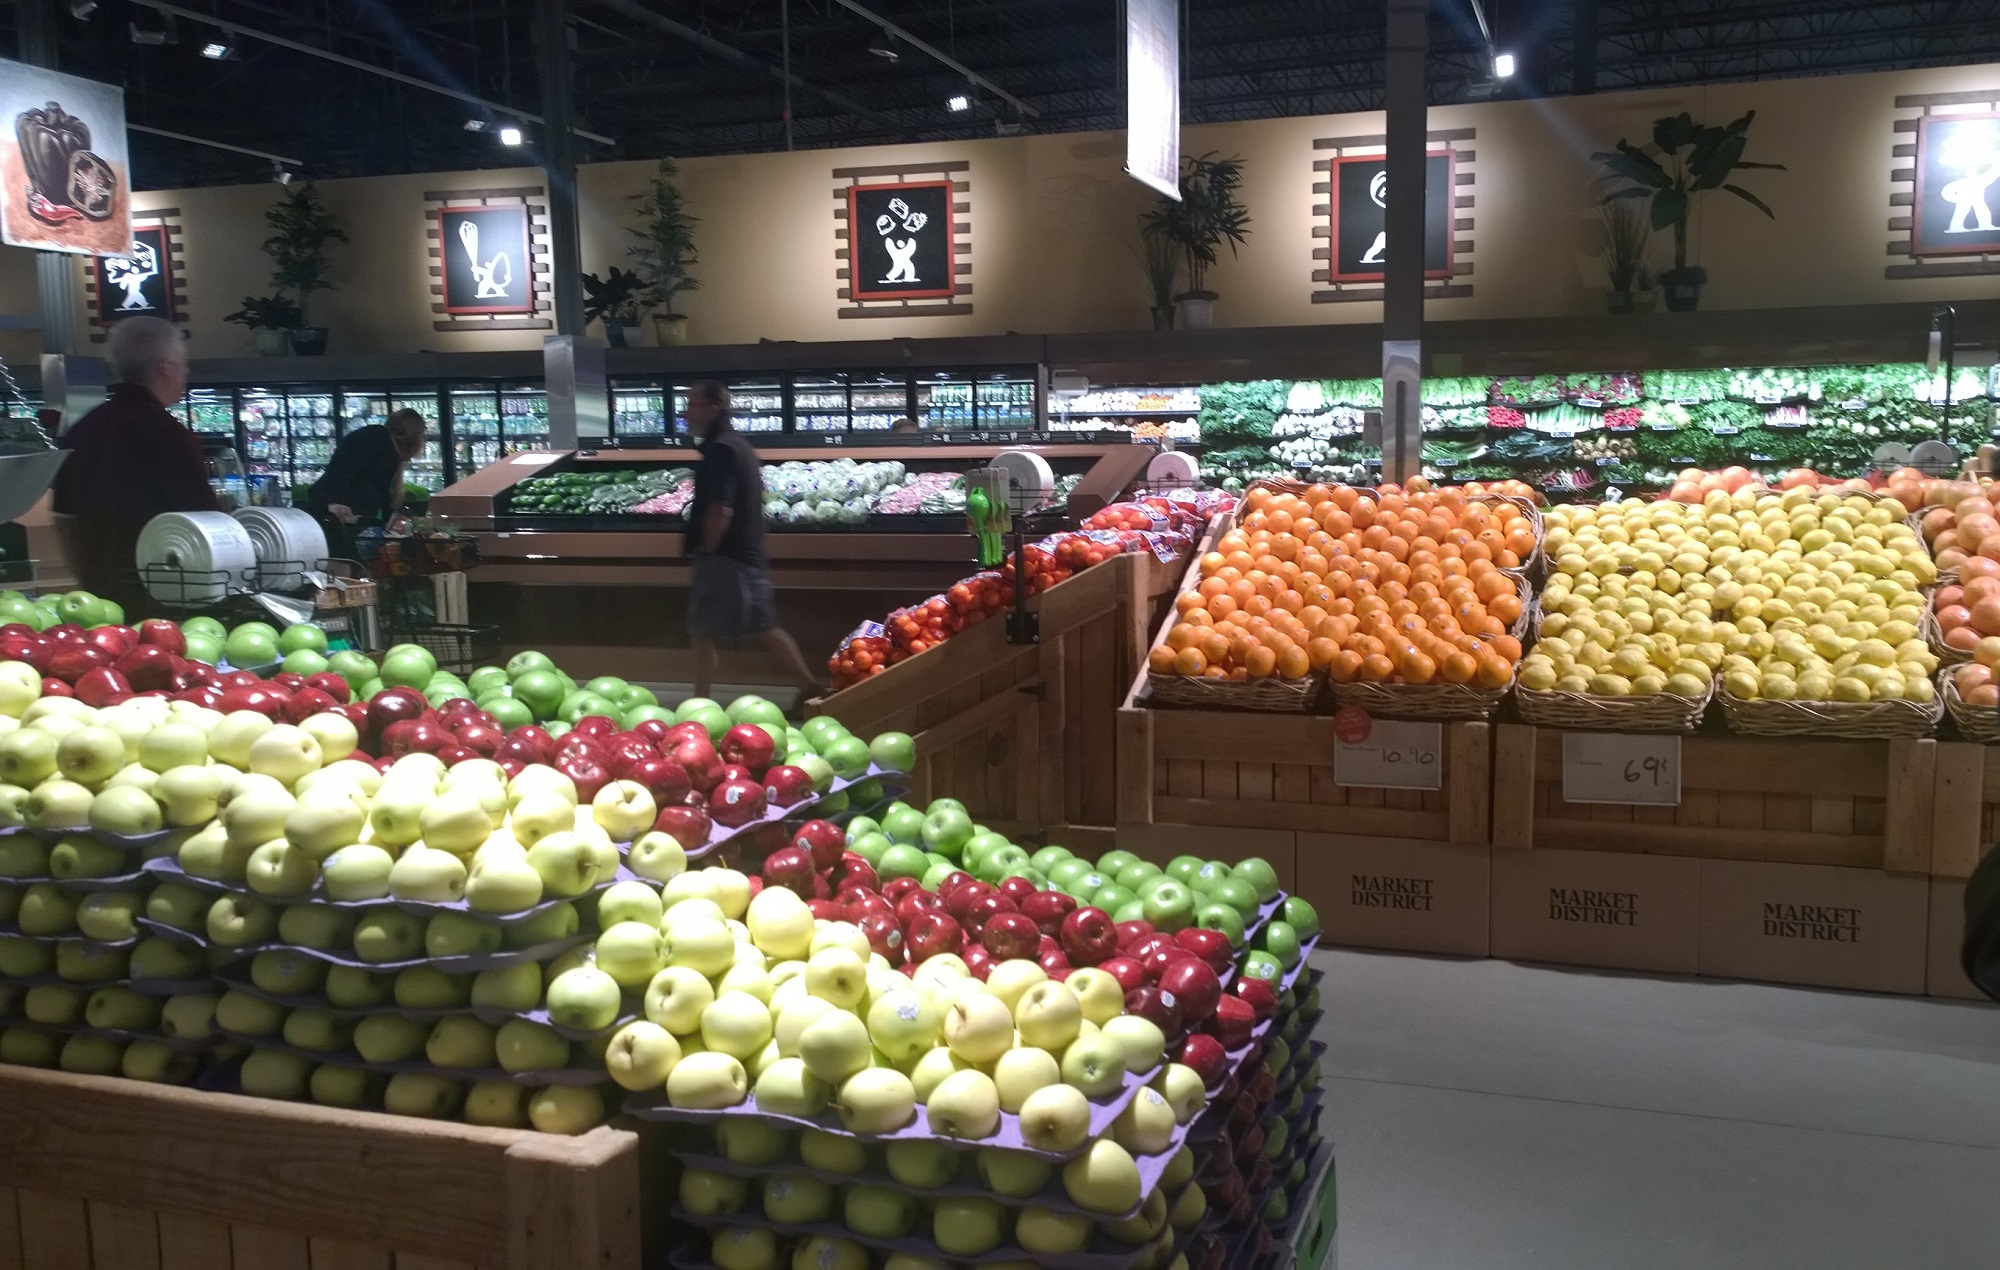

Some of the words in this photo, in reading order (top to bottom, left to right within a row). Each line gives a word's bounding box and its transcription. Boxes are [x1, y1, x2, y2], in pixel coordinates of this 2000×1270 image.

[1382, 747, 1401, 763] 10
[1351, 874, 1433, 896] MARKET
[1351, 890, 1434, 911] DISTRICT
[1549, 887, 1638, 910] MARKET
[1549, 904, 1638, 926] DISTRICT
[1763, 902, 1861, 926] MARKET
[1763, 919, 1861, 943] DISTRICT
